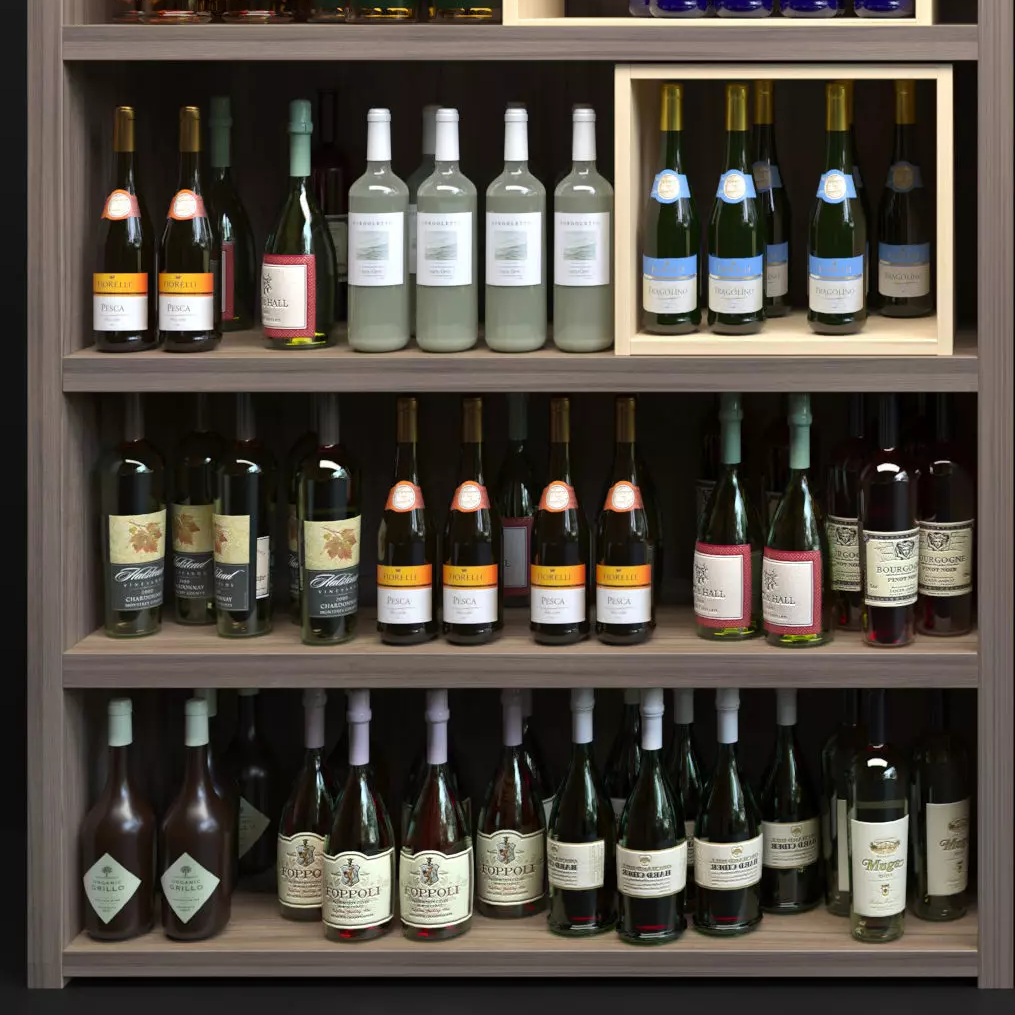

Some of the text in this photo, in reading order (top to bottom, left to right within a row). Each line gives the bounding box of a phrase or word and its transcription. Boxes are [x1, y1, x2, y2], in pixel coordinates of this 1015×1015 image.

[100, 302, 125, 313] PESCA
[167, 302, 191, 313] PESCA
[267, 299, 288, 308] HALL
[702, 589, 726, 598] HALL
[387, 596, 411, 606] PESCA
[453, 596, 477, 606] PESCA
[541, 596, 565, 606] PESCA
[607, 596, 631, 606] PESCA
[771, 596, 796, 605] HALL
[481, 864, 535, 876] FOPPOLI
[862, 858, 903, 873] Muga
[281, 868, 322, 878] FOPPO
[91, 884, 125, 892] GRILLO
[169, 884, 203, 892] GRILLO
[325, 887, 380, 899] FOPPOLI
[404, 885, 460, 898] FOPPOLI
